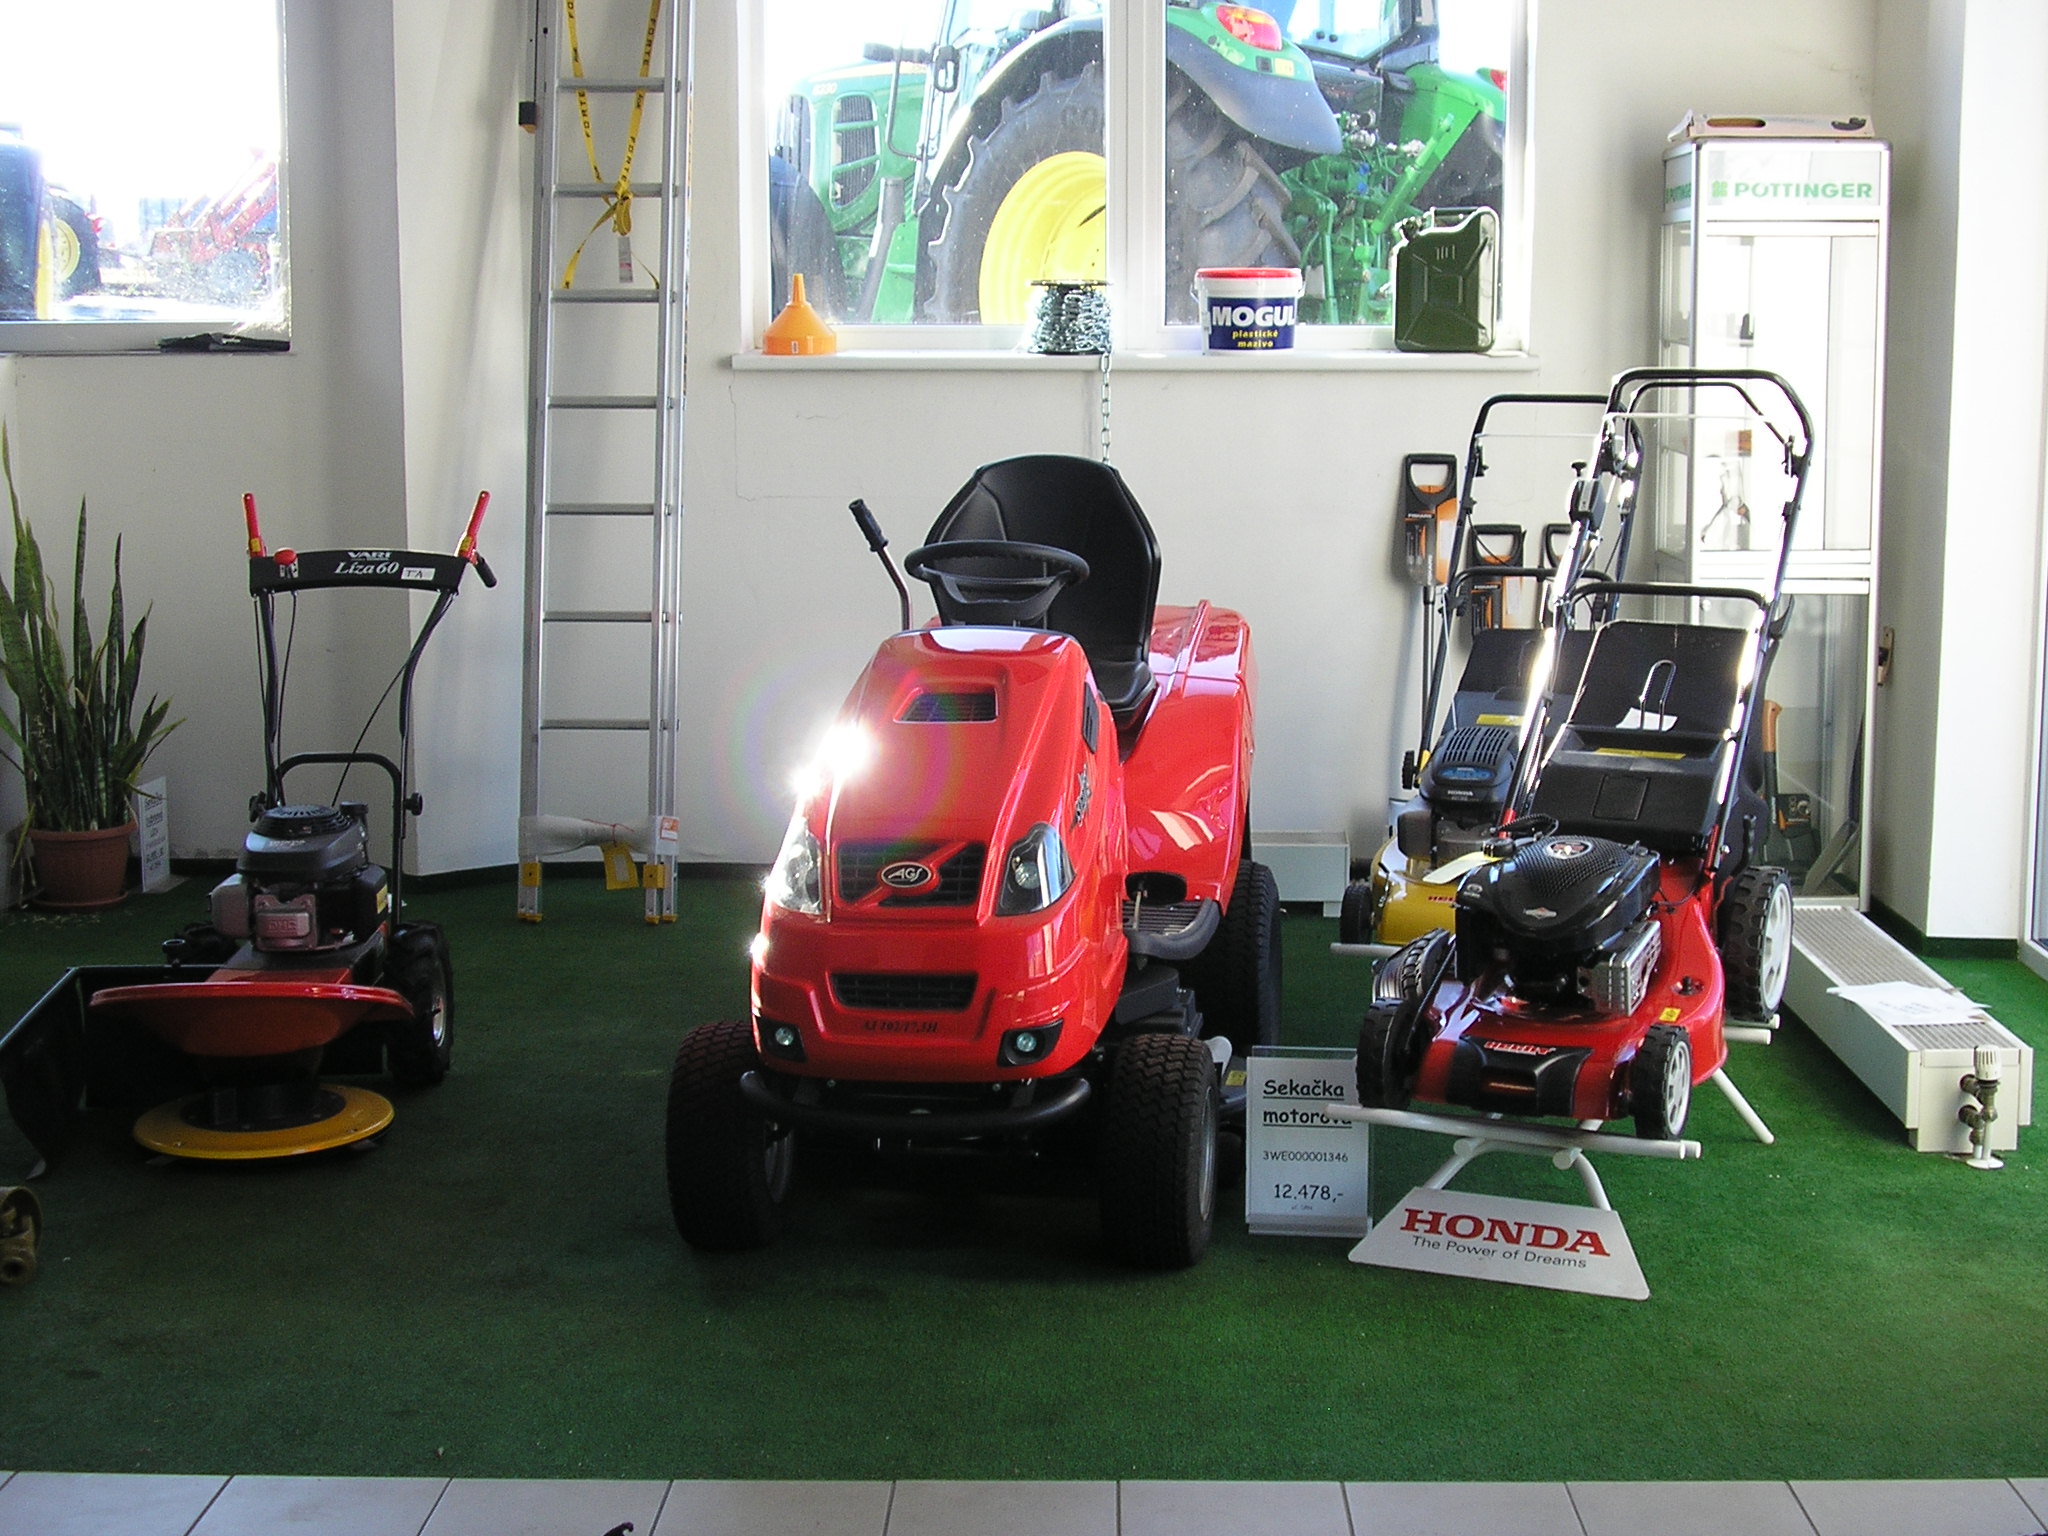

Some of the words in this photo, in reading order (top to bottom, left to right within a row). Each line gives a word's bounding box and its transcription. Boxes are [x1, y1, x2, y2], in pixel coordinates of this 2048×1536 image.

[1212, 305, 1295, 327] MOGUL
[1232, 330, 1278, 339] plastické
[1237, 340, 1274, 348] mazivo
[376, 561, 400, 575] 60
[888, 868, 922, 882] AGS
[1263, 1079, 1345, 1097] Sekačka
[1263, 1151, 1349, 1163] 3WE000001346
[1274, 1184, 1344, 1203] 12.478,-
[1400, 1208, 1611, 1257] HONDA
[1413, 1235, 1441, 1251] The
[1446, 1241, 1498, 1258] Power
[1502, 1249, 1518, 1260] of
[1524, 1252, 1587, 1269] Dreams
